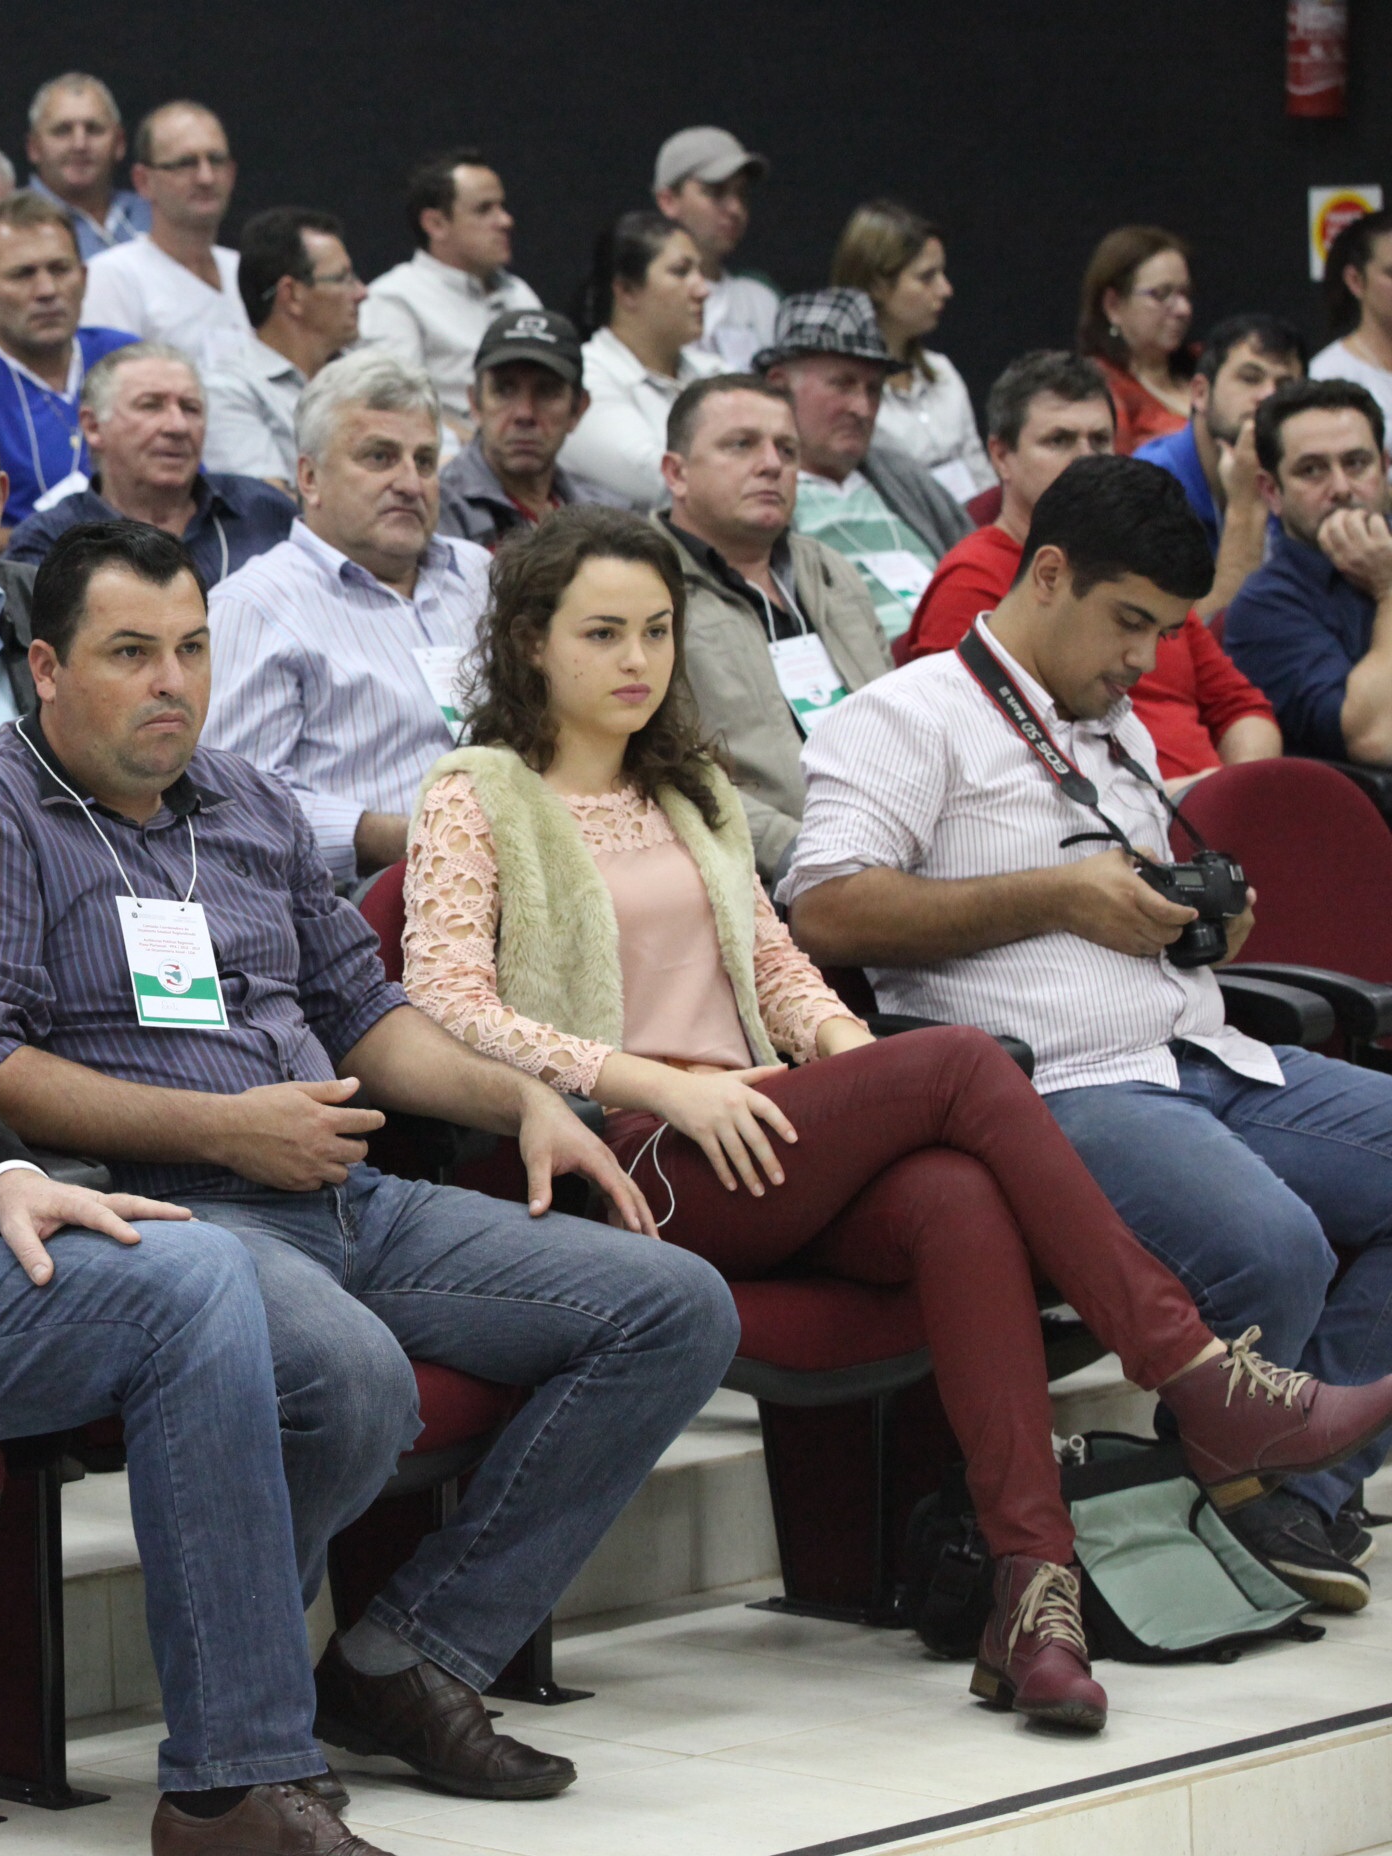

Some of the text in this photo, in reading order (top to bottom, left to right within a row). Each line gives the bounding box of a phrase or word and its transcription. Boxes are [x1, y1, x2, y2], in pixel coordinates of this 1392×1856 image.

[1007, 696, 1028, 721] Mark
[1021, 722, 1042, 740] 5D
[1035, 741, 1069, 774] EOS
